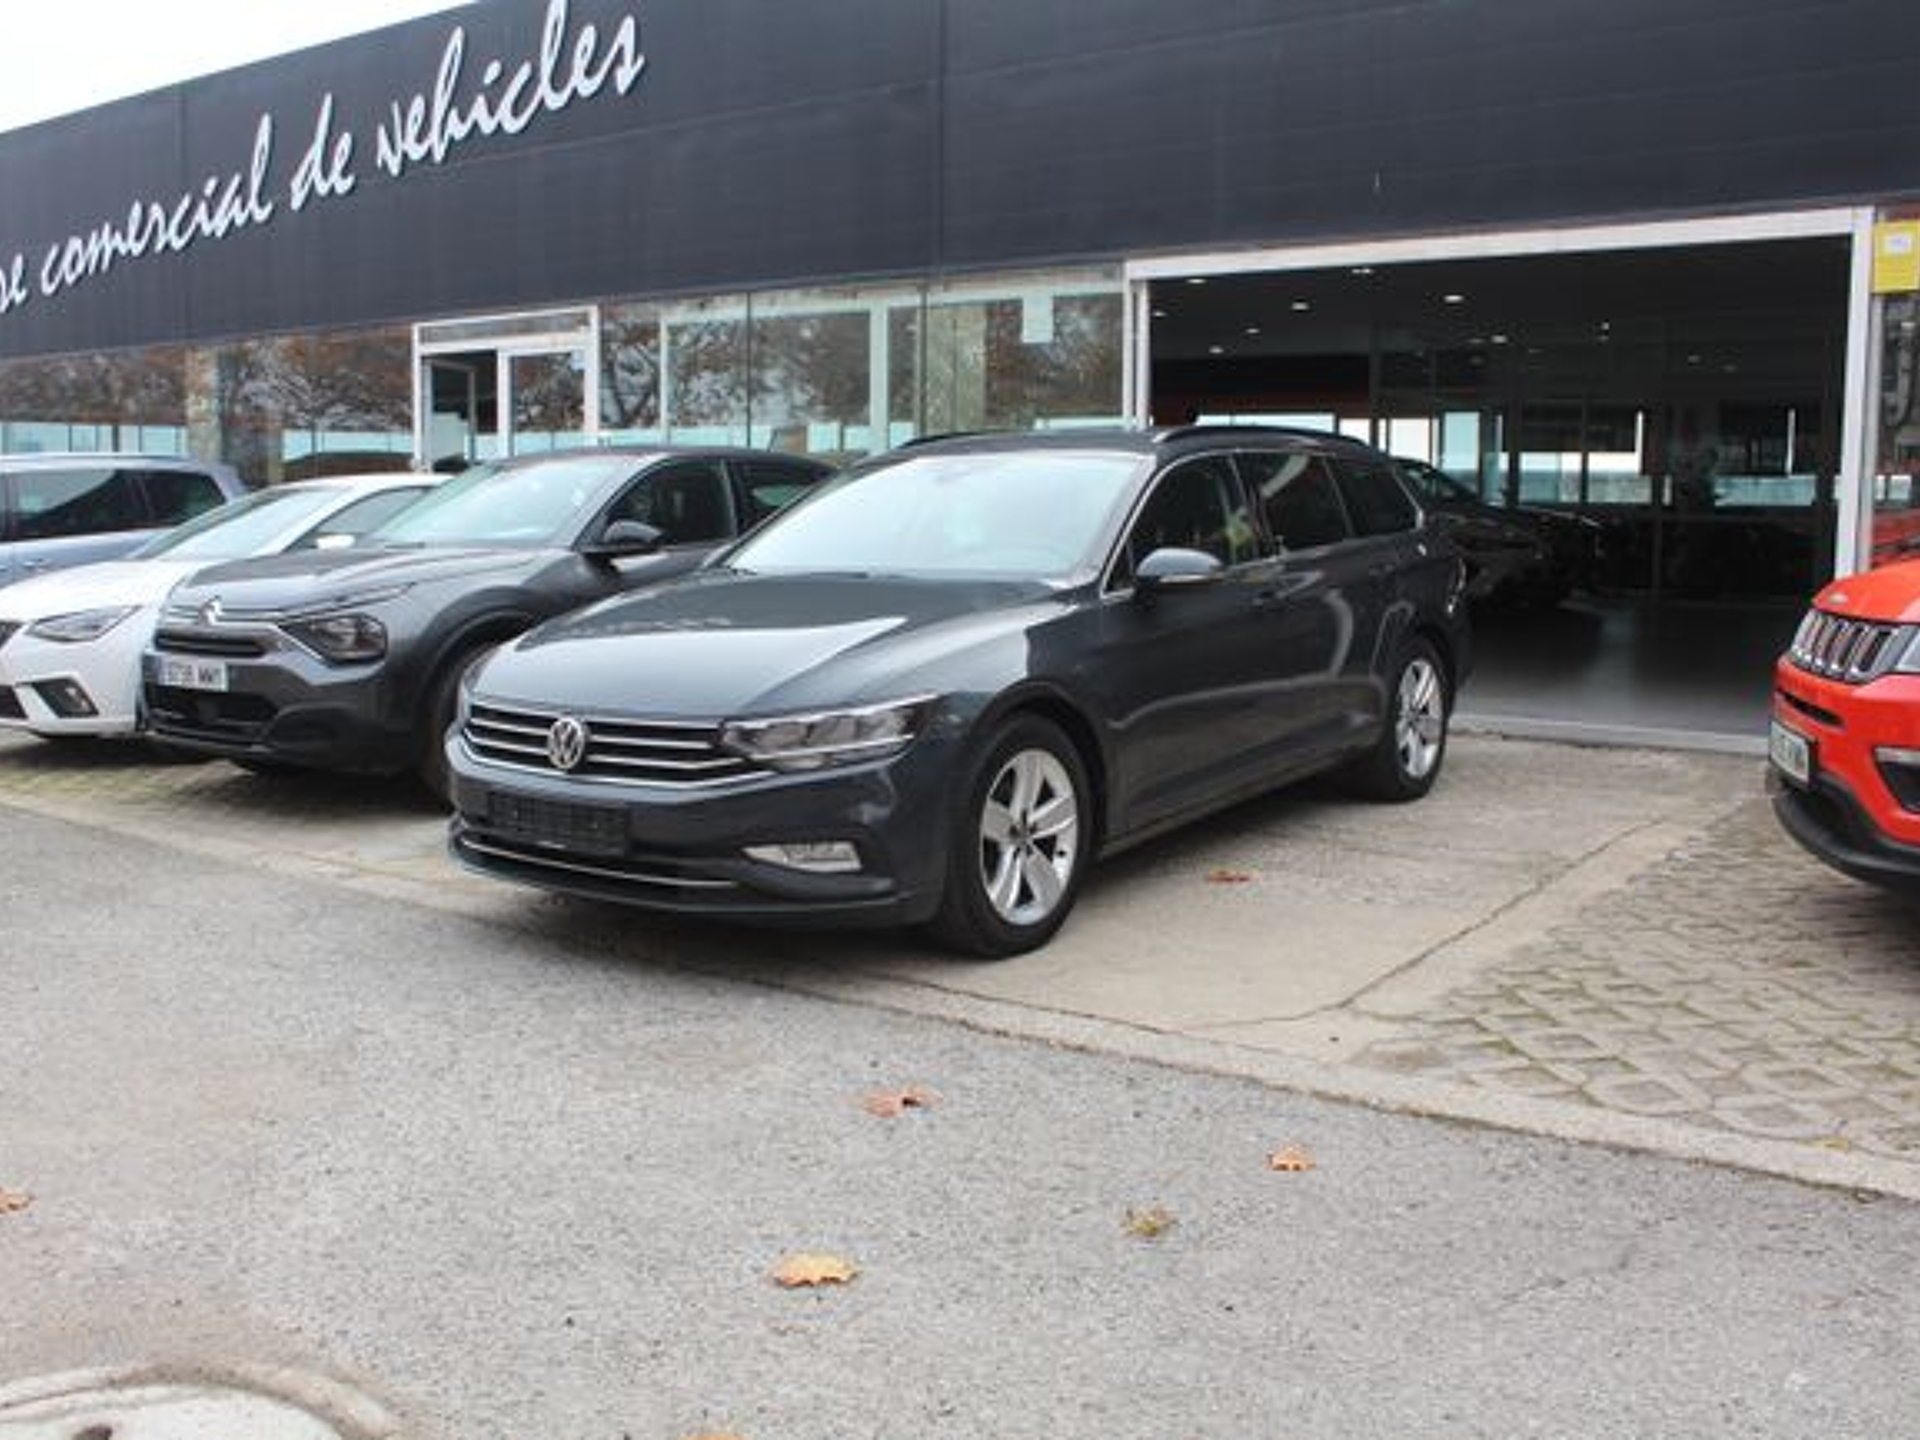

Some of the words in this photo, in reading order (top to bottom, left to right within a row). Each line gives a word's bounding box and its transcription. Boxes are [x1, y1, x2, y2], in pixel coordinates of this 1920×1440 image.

[40, 113, 273, 296] comercial
[291, 94, 355, 211] de
[377, 0, 645, 176] vehicles
